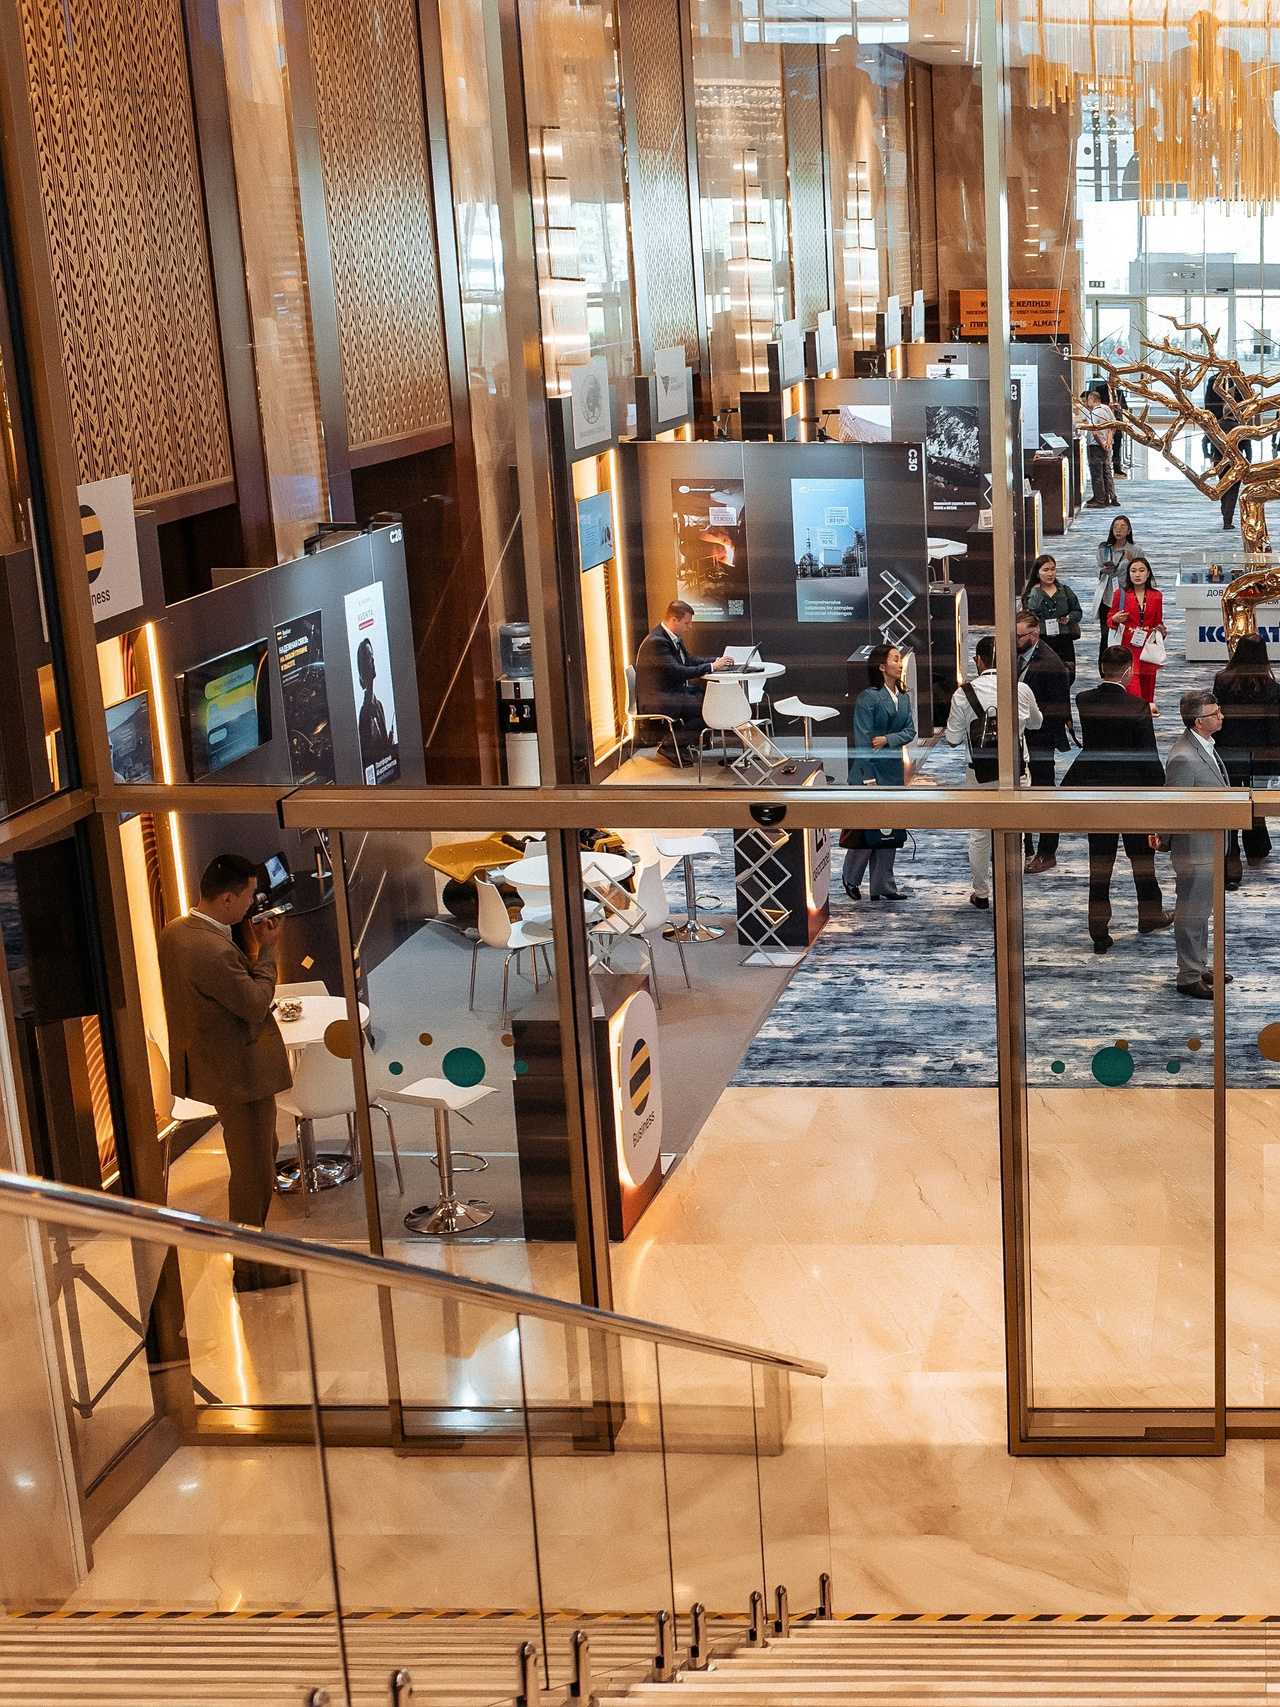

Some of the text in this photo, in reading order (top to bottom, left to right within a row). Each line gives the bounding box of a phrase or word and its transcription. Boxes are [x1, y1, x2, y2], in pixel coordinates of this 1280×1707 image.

[1010, 384, 1018, 401] C32
[908, 448, 918, 472] C30
[91, 589, 111, 607] ness
[632, 1110, 655, 1148] Business
